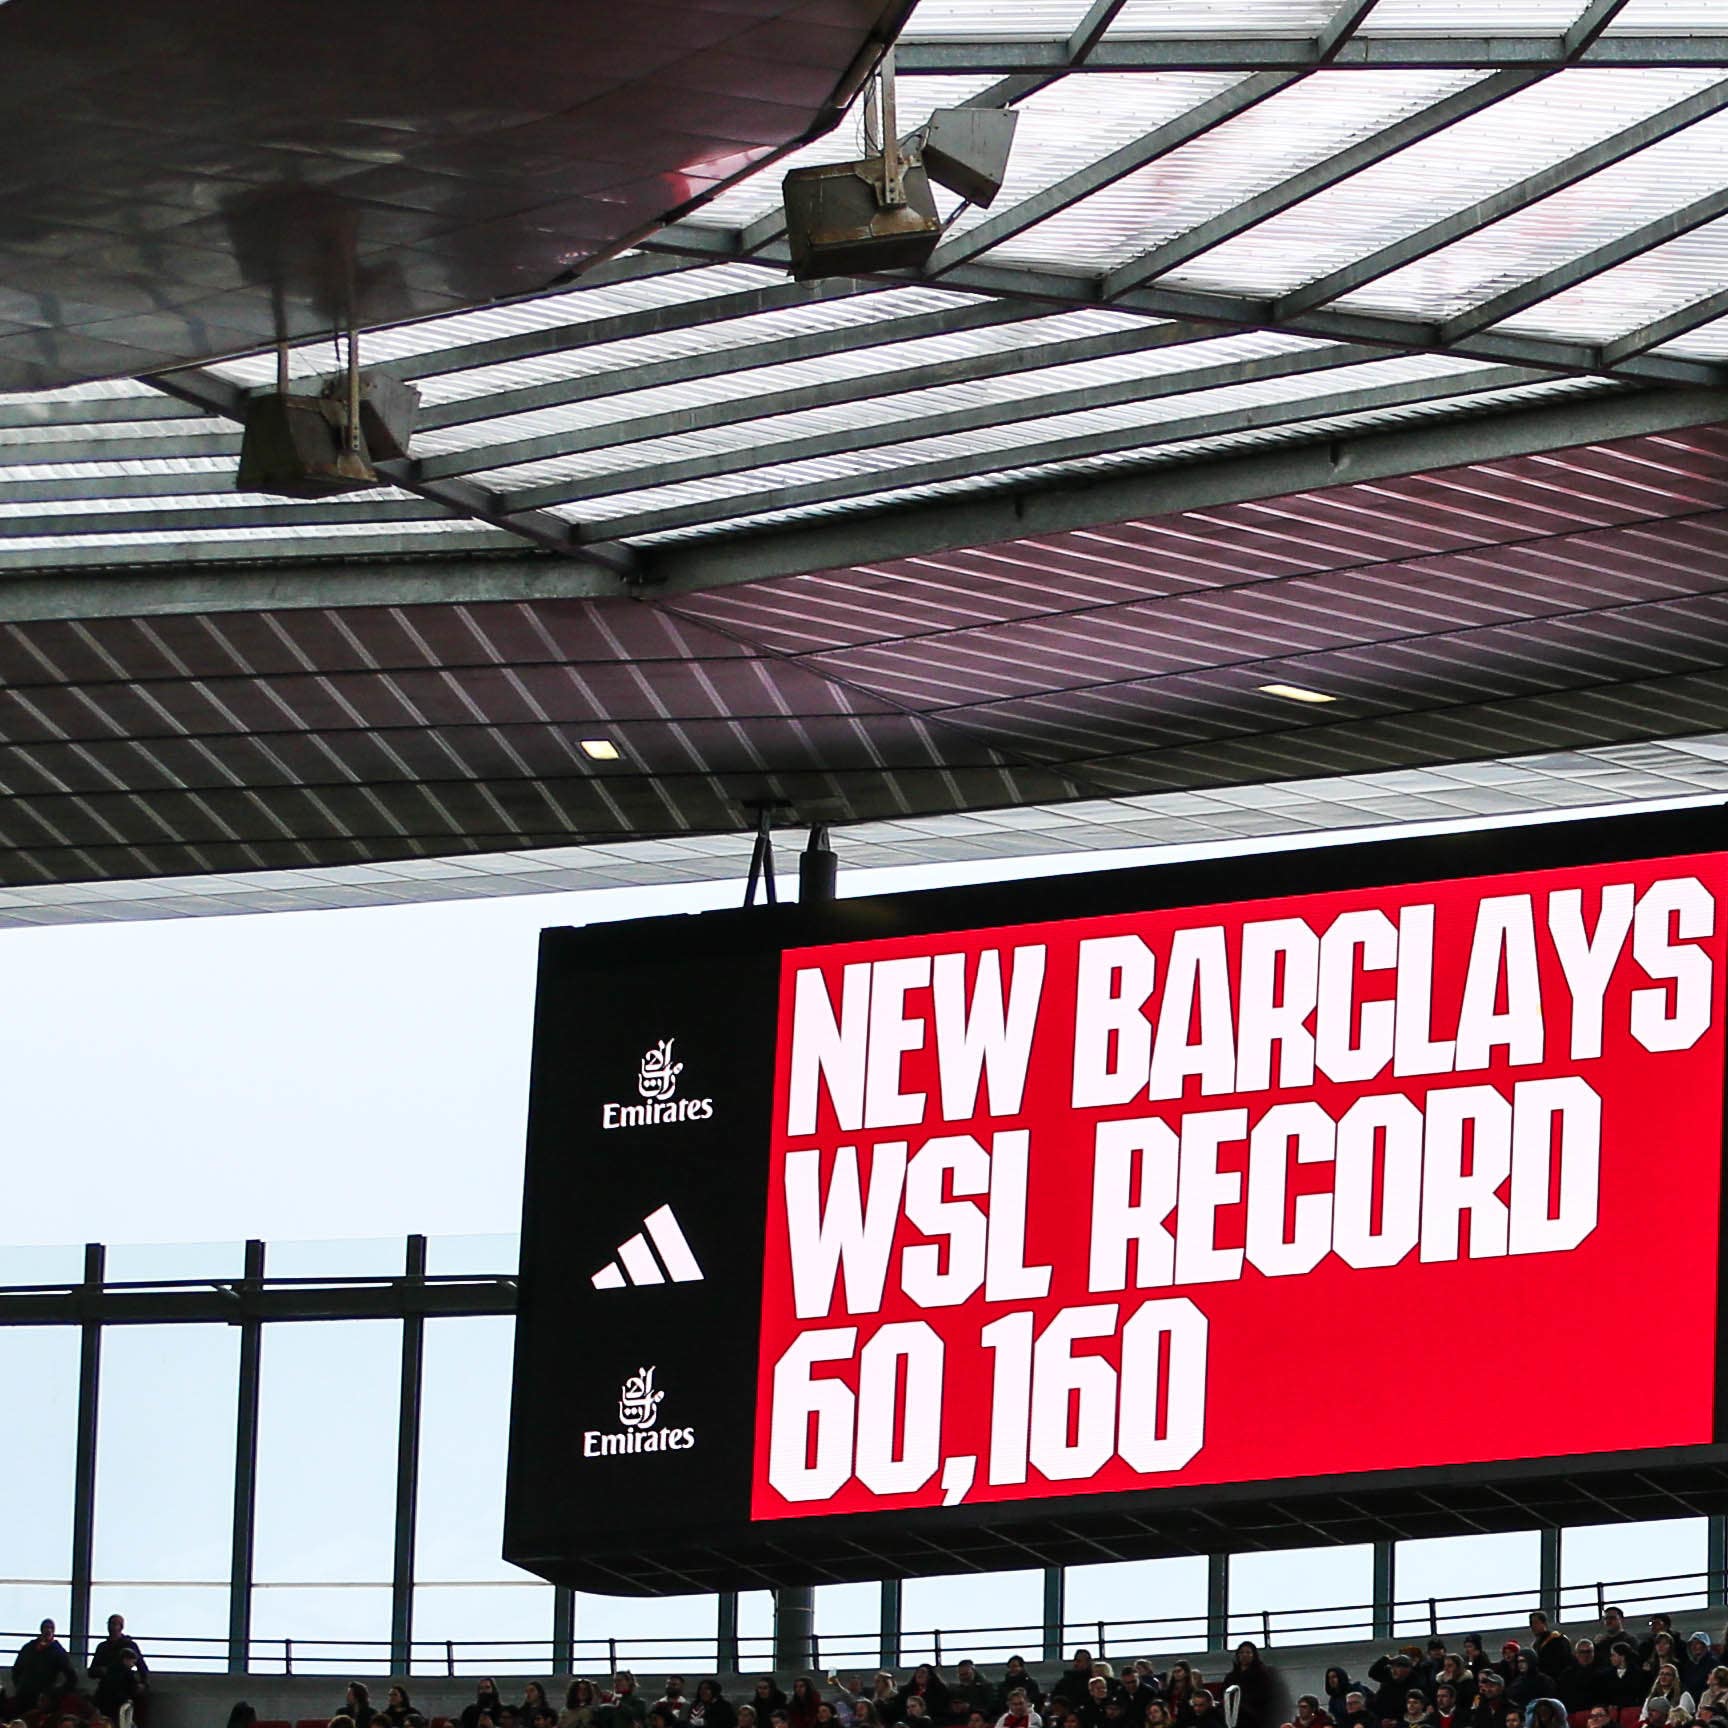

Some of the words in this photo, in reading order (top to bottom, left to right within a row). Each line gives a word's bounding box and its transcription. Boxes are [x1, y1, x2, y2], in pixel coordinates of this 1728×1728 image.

[788, 945, 1045, 1136] NEW
[1072, 878, 1714, 1108] BARCLAYS
[602, 1098, 713, 1129] Emirates
[785, 1130, 1052, 1318] WSL
[1089, 1077, 1601, 1292] RECORD
[583, 1426, 695, 1458] Emirates
[769, 1298, 1207, 1506] 60,160
